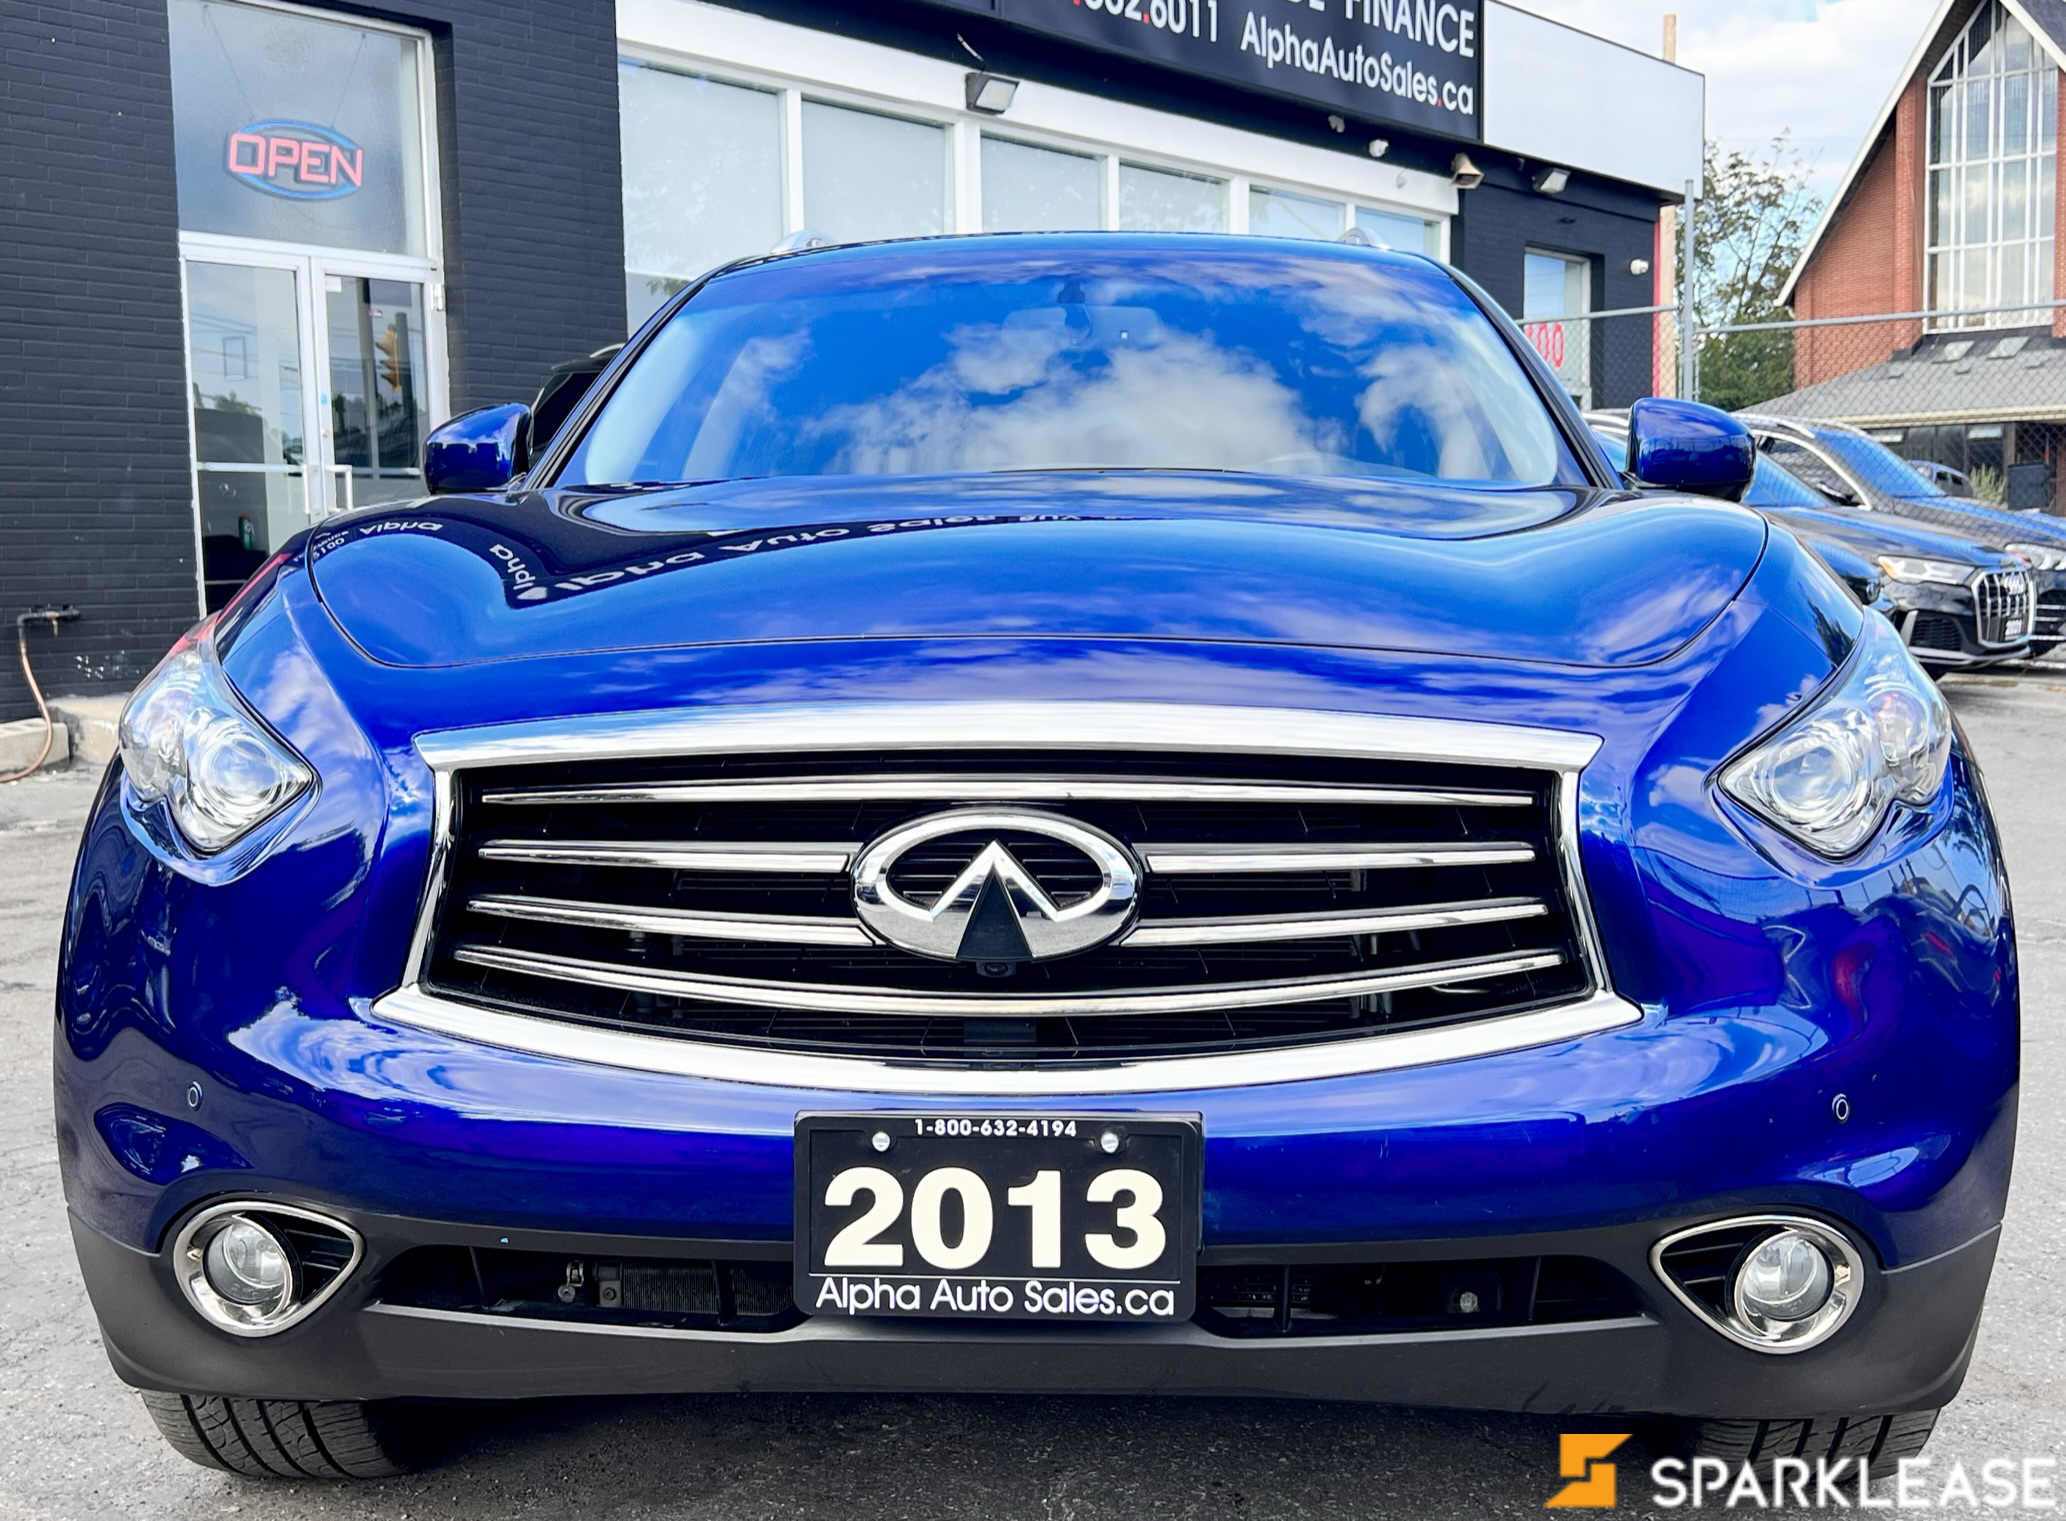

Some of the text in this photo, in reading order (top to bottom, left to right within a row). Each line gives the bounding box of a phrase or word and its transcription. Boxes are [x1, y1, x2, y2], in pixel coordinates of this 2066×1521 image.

[1240, 11, 1475, 115] AlphaAutoSales.ca
[228, 132, 364, 187] OPEN
[1524, 321, 1565, 369] 00
[914, 1118, 1077, 1137] 1-800-632-4194
[824, 1166, 1167, 1270] 2013
[815, 1276, 1175, 1316] Alpha Auto Sales.ca
